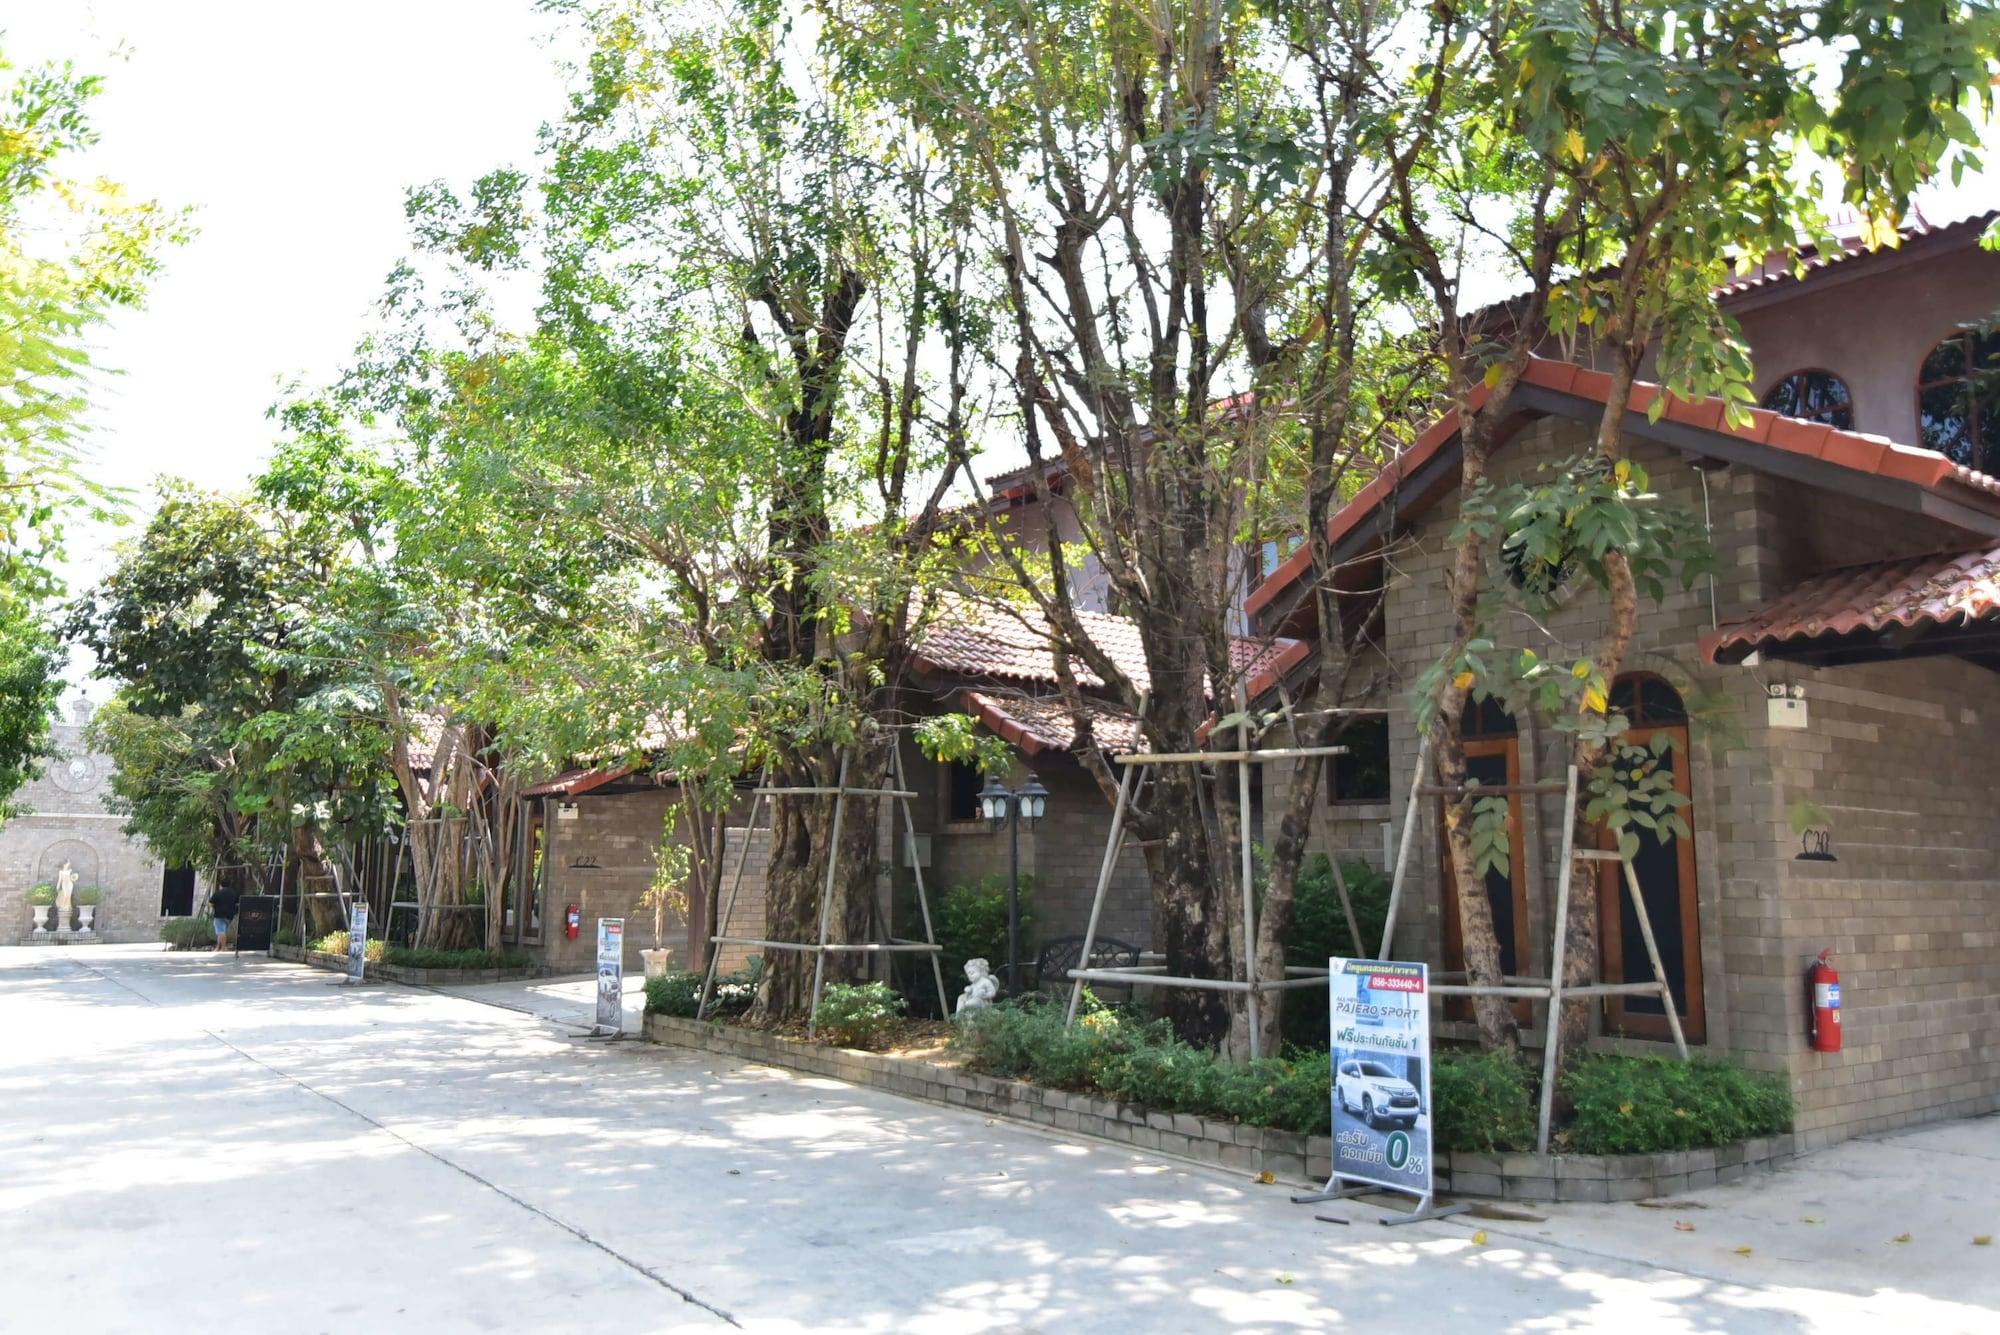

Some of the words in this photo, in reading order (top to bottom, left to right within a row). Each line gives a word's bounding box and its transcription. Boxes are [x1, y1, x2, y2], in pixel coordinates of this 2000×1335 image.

[1372, 976, 1420, 990] 056-333440-4
[1336, 1002, 1378, 1015] PAJERO
[1381, 1006, 1419, 1019] SPORT
